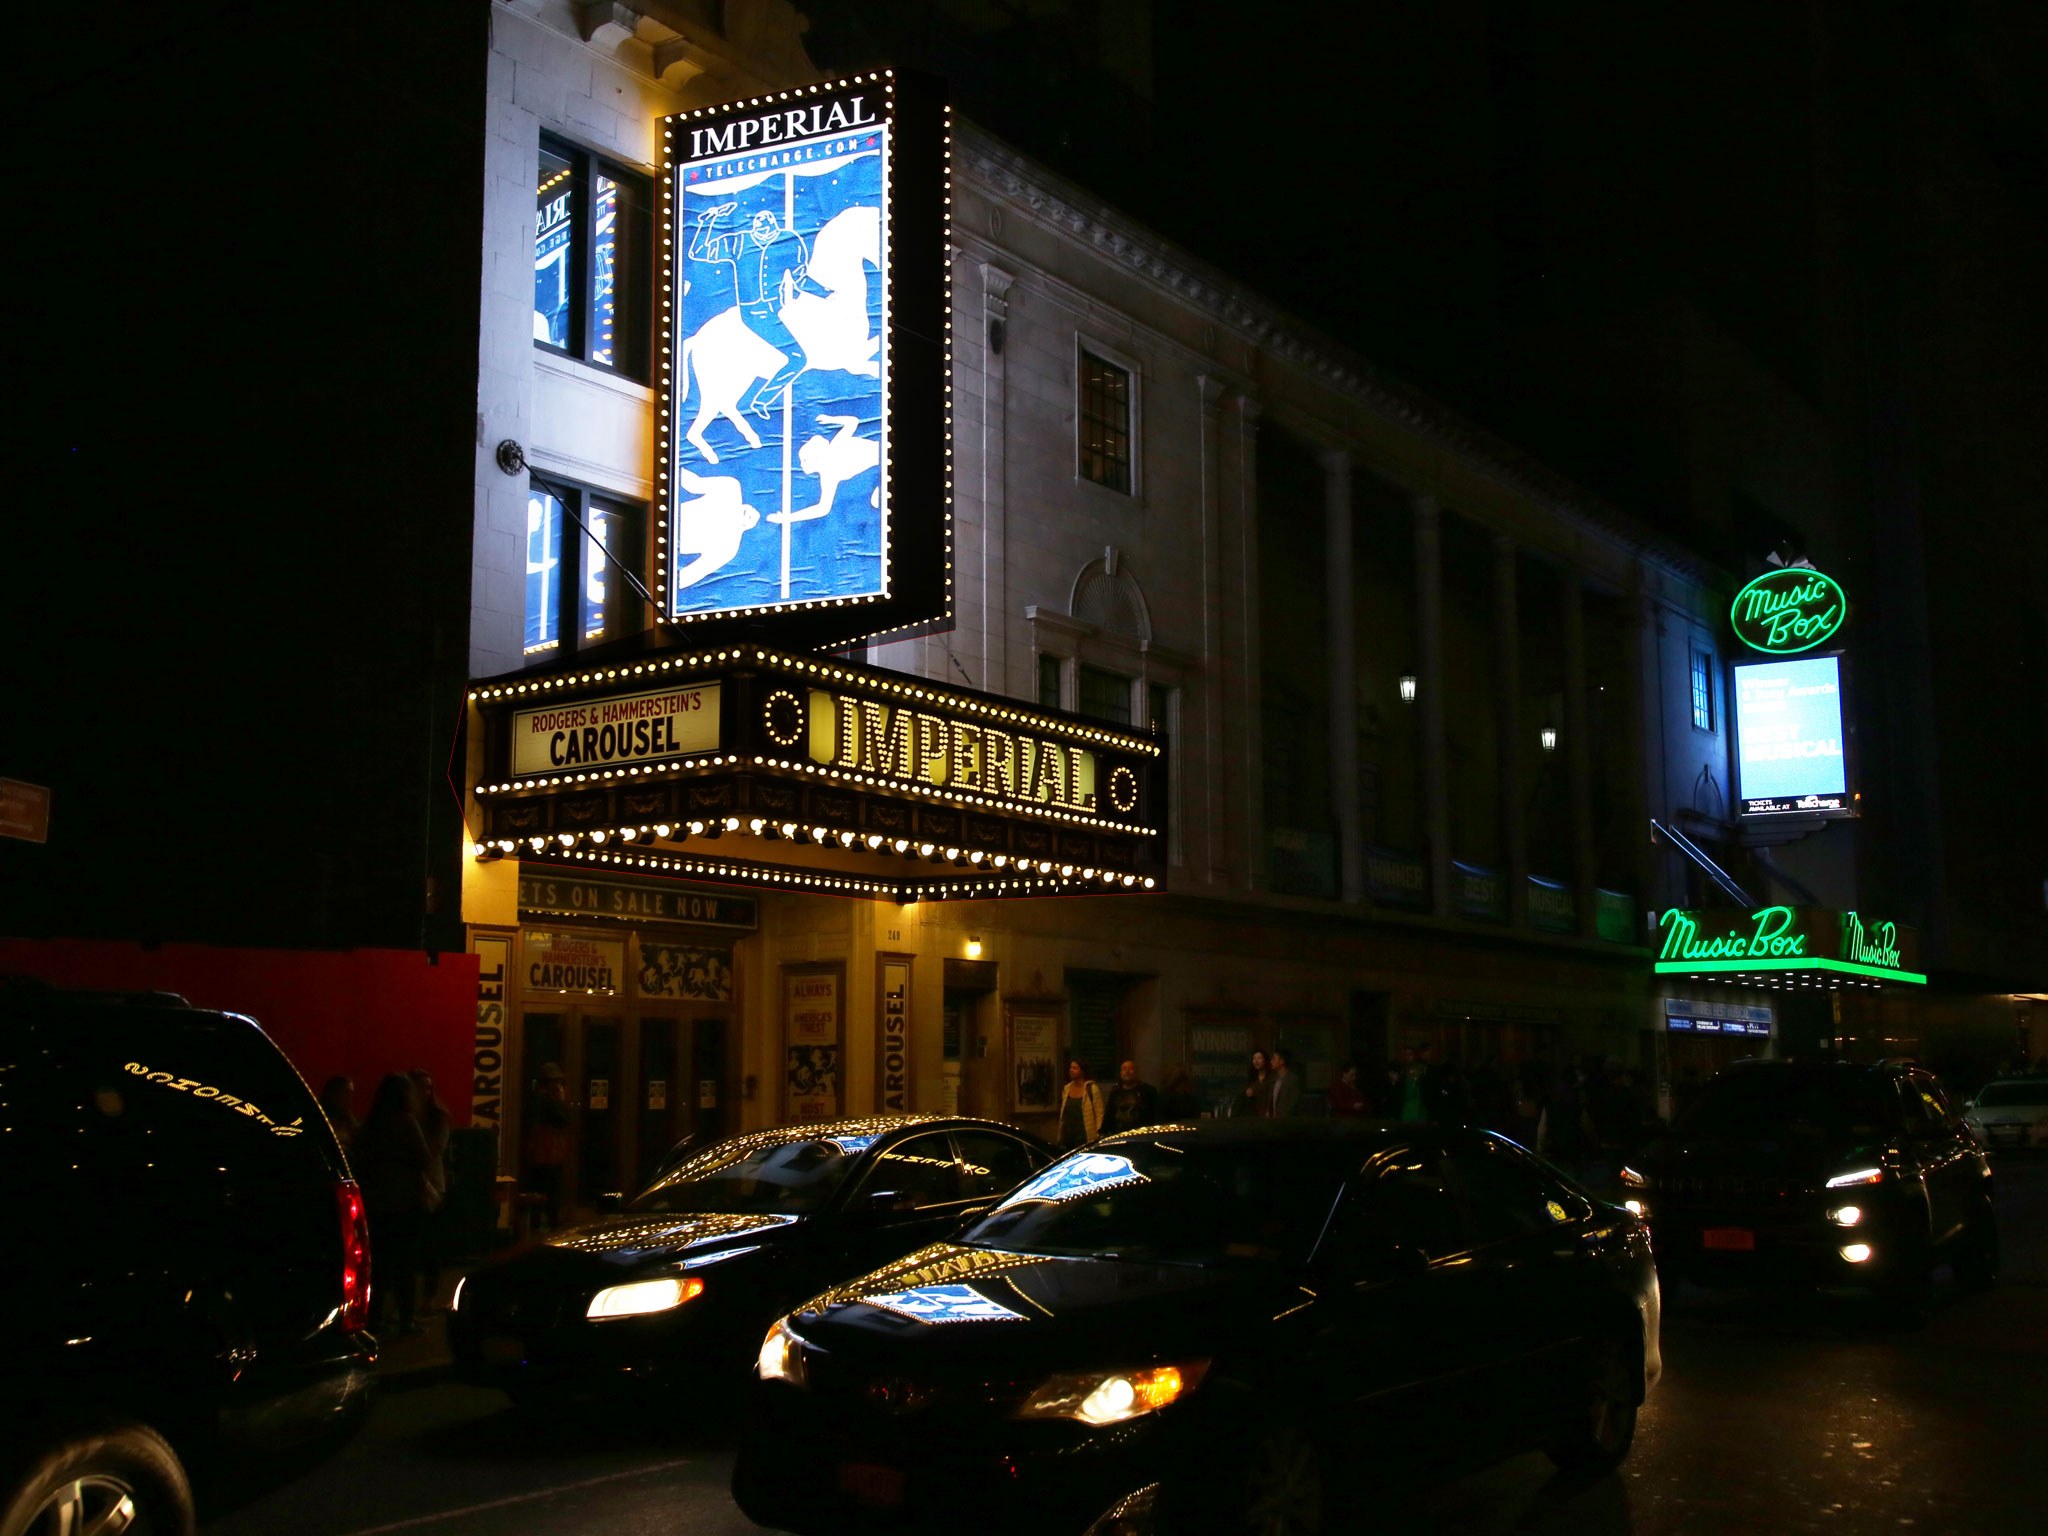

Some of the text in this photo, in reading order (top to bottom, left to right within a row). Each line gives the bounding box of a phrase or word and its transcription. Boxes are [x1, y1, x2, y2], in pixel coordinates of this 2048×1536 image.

[690, 96, 876, 158] IMPERIAL
[705, 138, 858, 179] TELECHARGE.COM
[1744, 577, 1826, 622] Music
[1760, 604, 1837, 646] Box
[532, 691, 701, 733] RODGERS & HAMMERSTEIN'S
[550, 716, 681, 767] CAROUSEL
[838, 695, 1097, 813] IMPERIAL
[518, 882, 719, 920] ETS ON SALE NOW
[1660, 905, 1805, 959] Music Box
[1849, 911, 1900, 968] Music Box
[529, 962, 616, 991] CAROUSEL
[793, 983, 833, 998] ALWAYS
[473, 962, 504, 1131] AROUSEL
[885, 984, 905, 1111] AROUSEL
